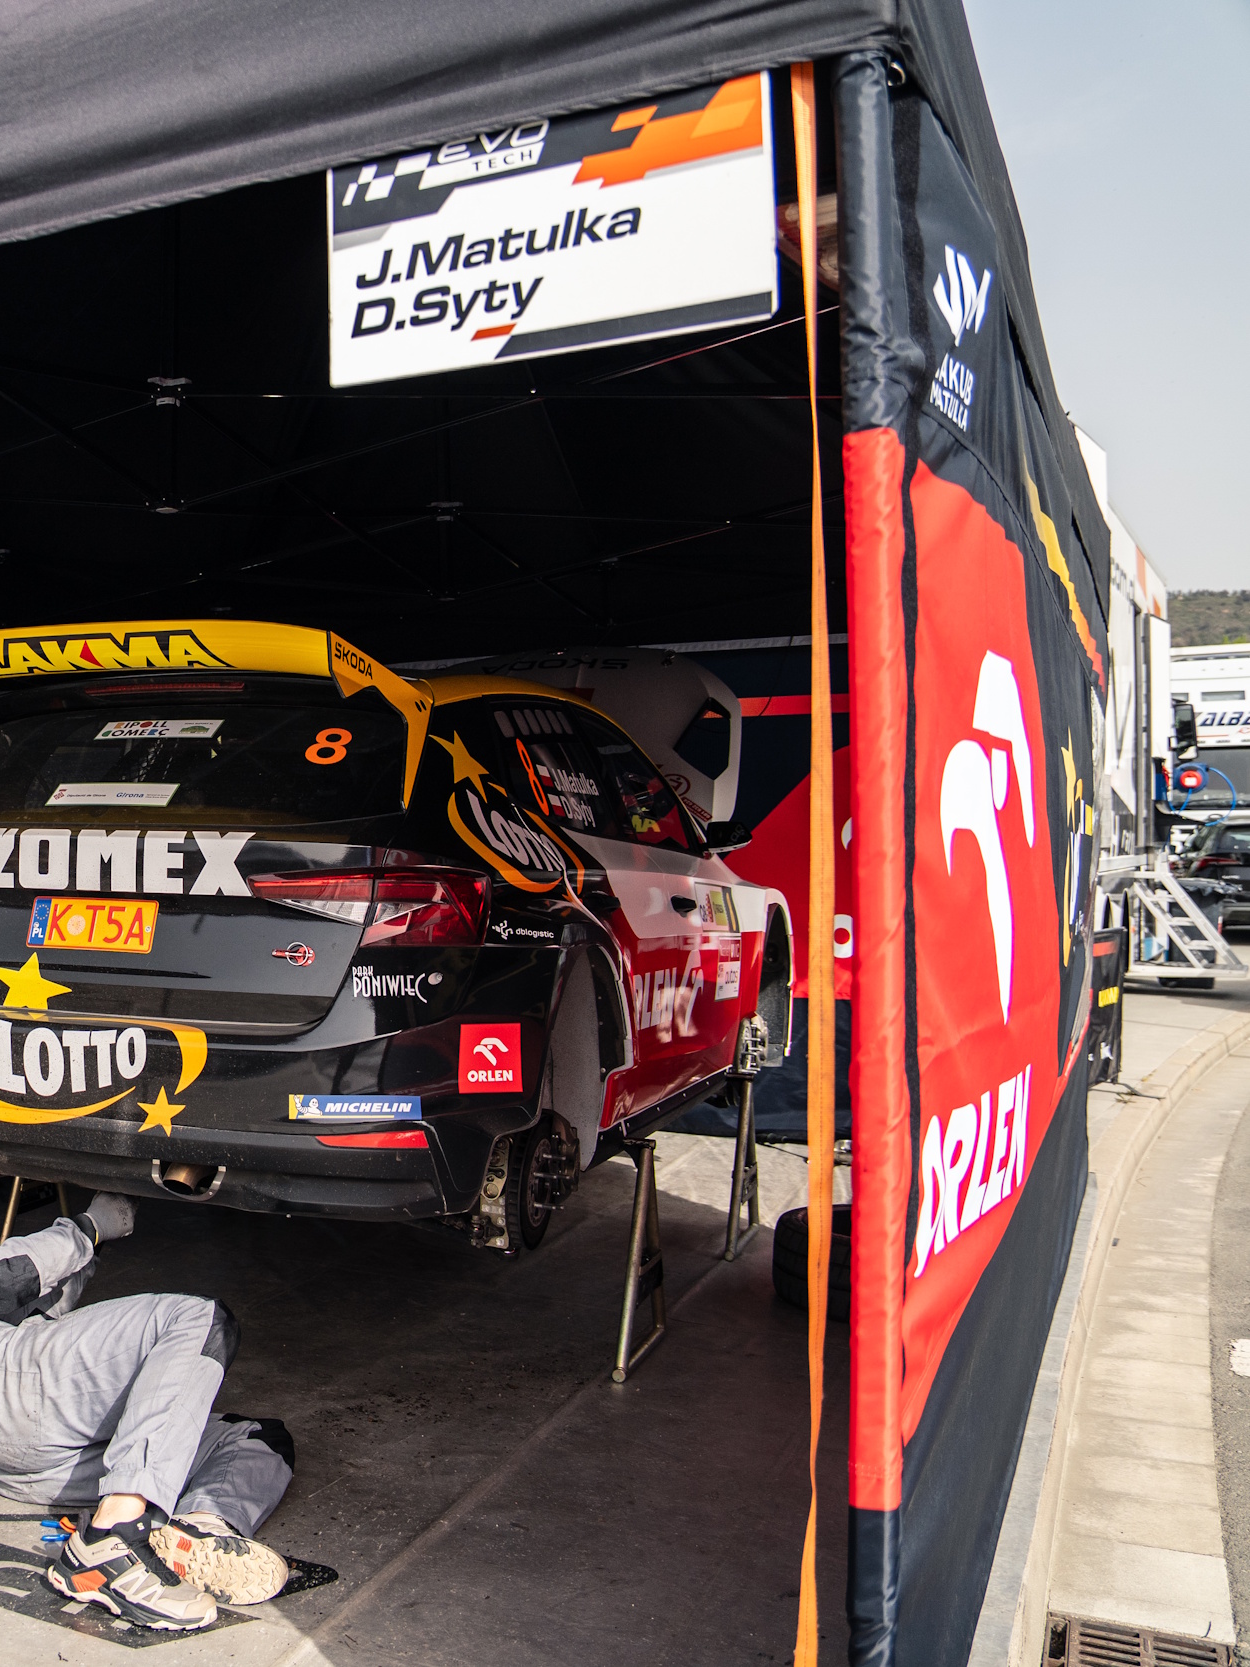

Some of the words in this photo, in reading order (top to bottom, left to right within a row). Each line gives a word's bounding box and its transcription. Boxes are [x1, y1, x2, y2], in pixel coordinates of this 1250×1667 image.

[437, 119, 549, 164] EVO
[472, 149, 533, 172] TECH
[356, 205, 643, 290] J.Matulka
[350, 275, 545, 339] D.Syty
[304, 728, 352, 765] 8
[515, 738, 550, 816] 8
[467, 789, 567, 872] LOTTO
[31, 928, 44, 938] PL
[515, 927, 555, 939] dblogistic
[351, 965, 374, 978] PARK
[352, 972, 428, 1004] PONIWIEC
[467, 1069, 513, 1083] ORLEN
[324, 1102, 413, 1113] MICHELIN
